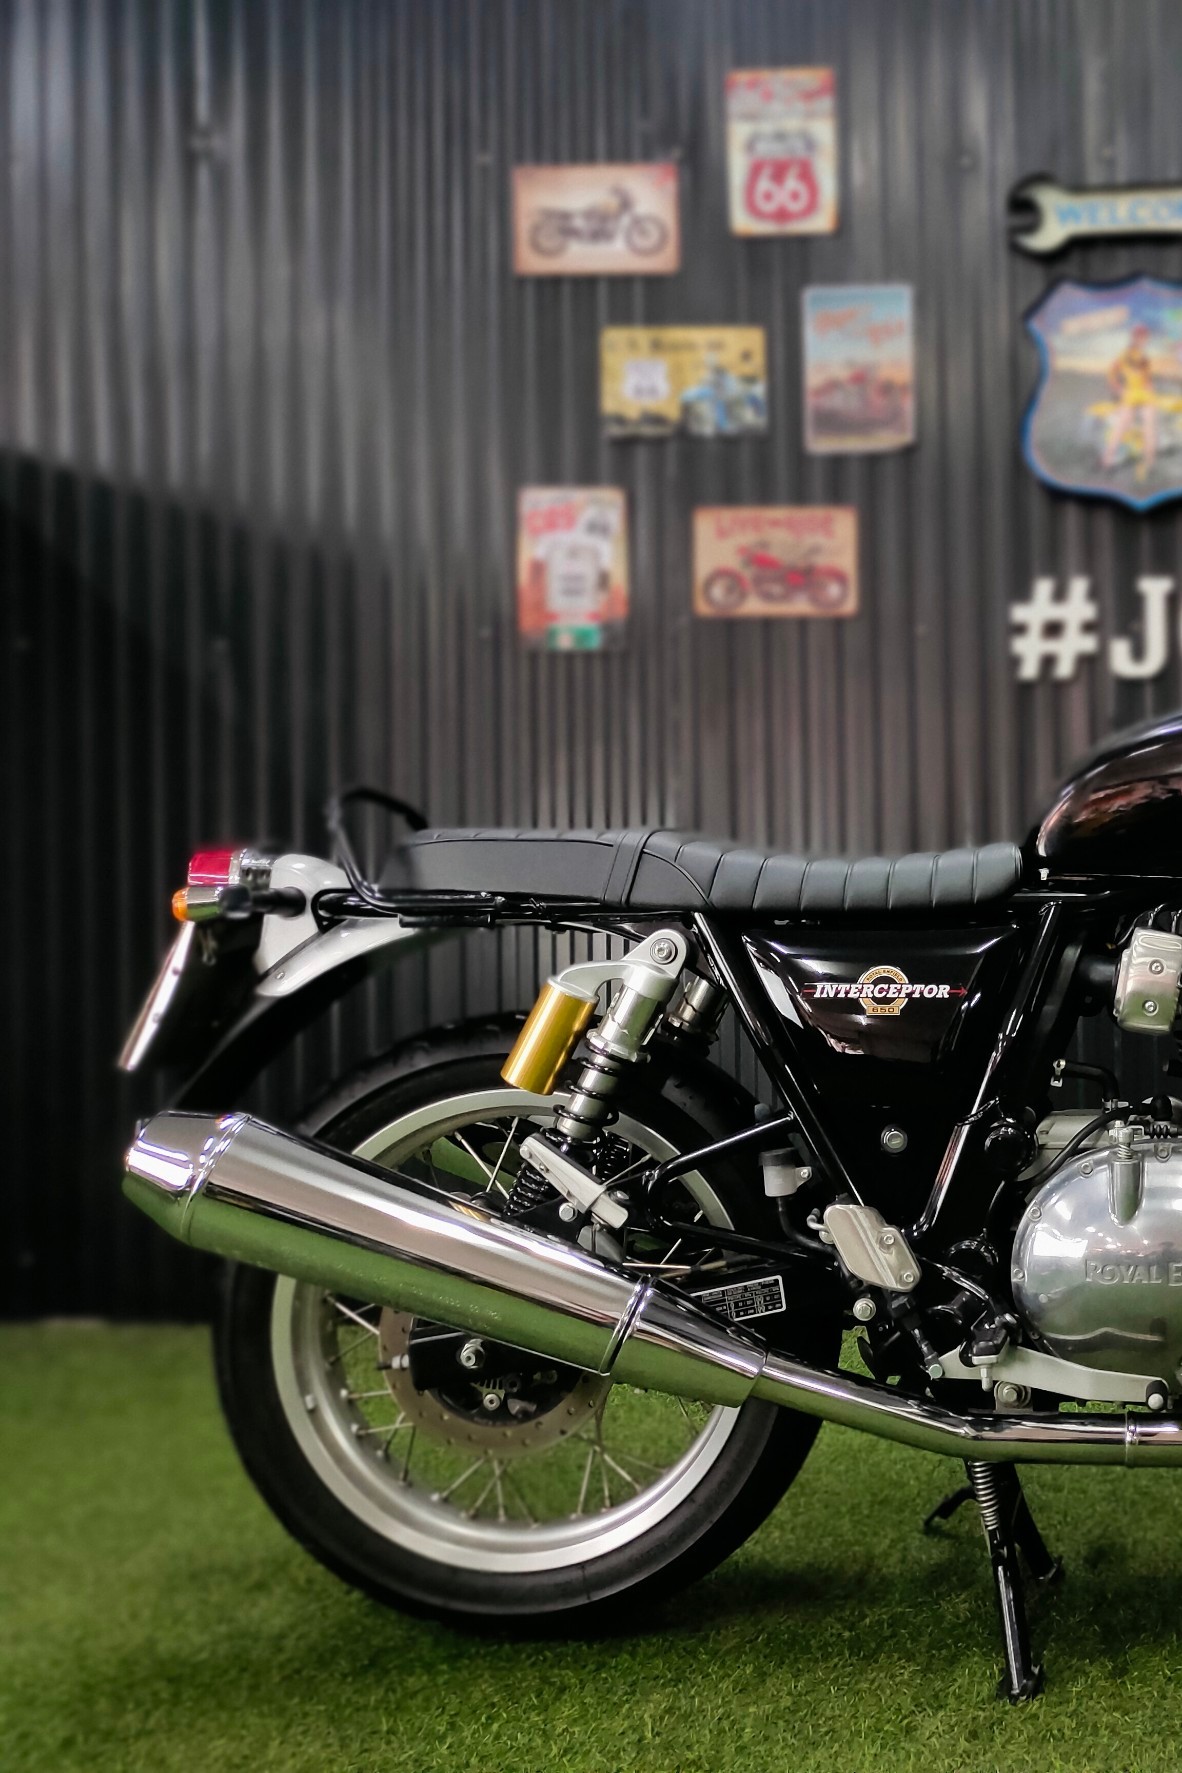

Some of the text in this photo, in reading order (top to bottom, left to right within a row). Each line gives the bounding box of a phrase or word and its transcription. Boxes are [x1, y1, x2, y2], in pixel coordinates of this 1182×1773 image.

[754, 163, 811, 214] 66
[813, 984, 950, 998] INTERCEPTOR
[1085, 1259, 1162, 1284] ROYAL
